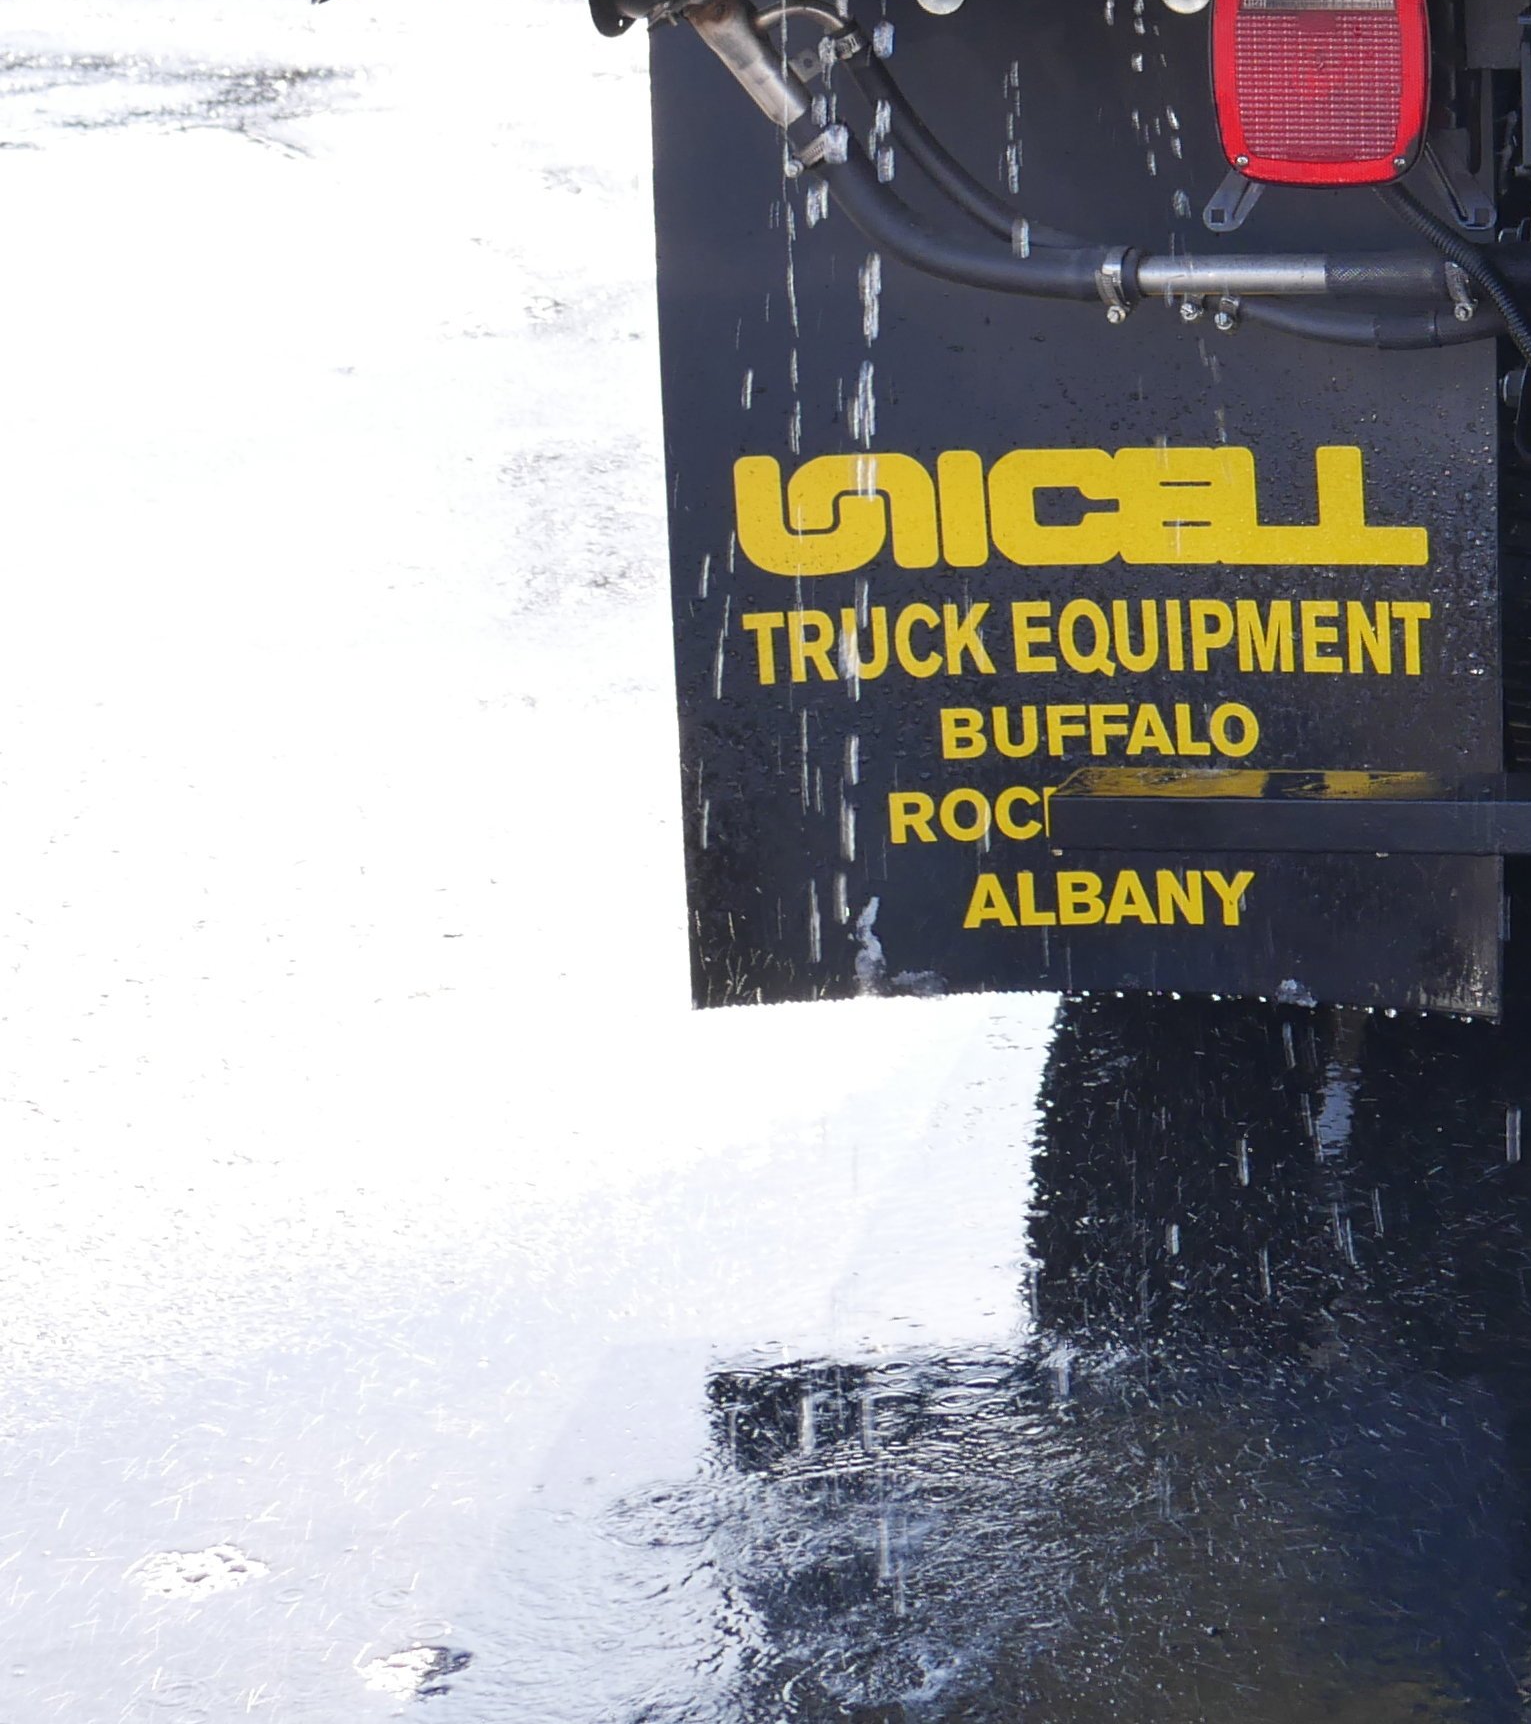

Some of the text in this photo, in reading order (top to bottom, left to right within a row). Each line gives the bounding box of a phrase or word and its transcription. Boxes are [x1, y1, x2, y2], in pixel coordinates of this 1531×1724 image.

[734, 446, 1429, 576] UNICELL
[742, 599, 1431, 684] TRUCK EQUIPMENT
[940, 703, 1259, 759] BUFFALO
[963, 870, 1254, 928] ALBANY
